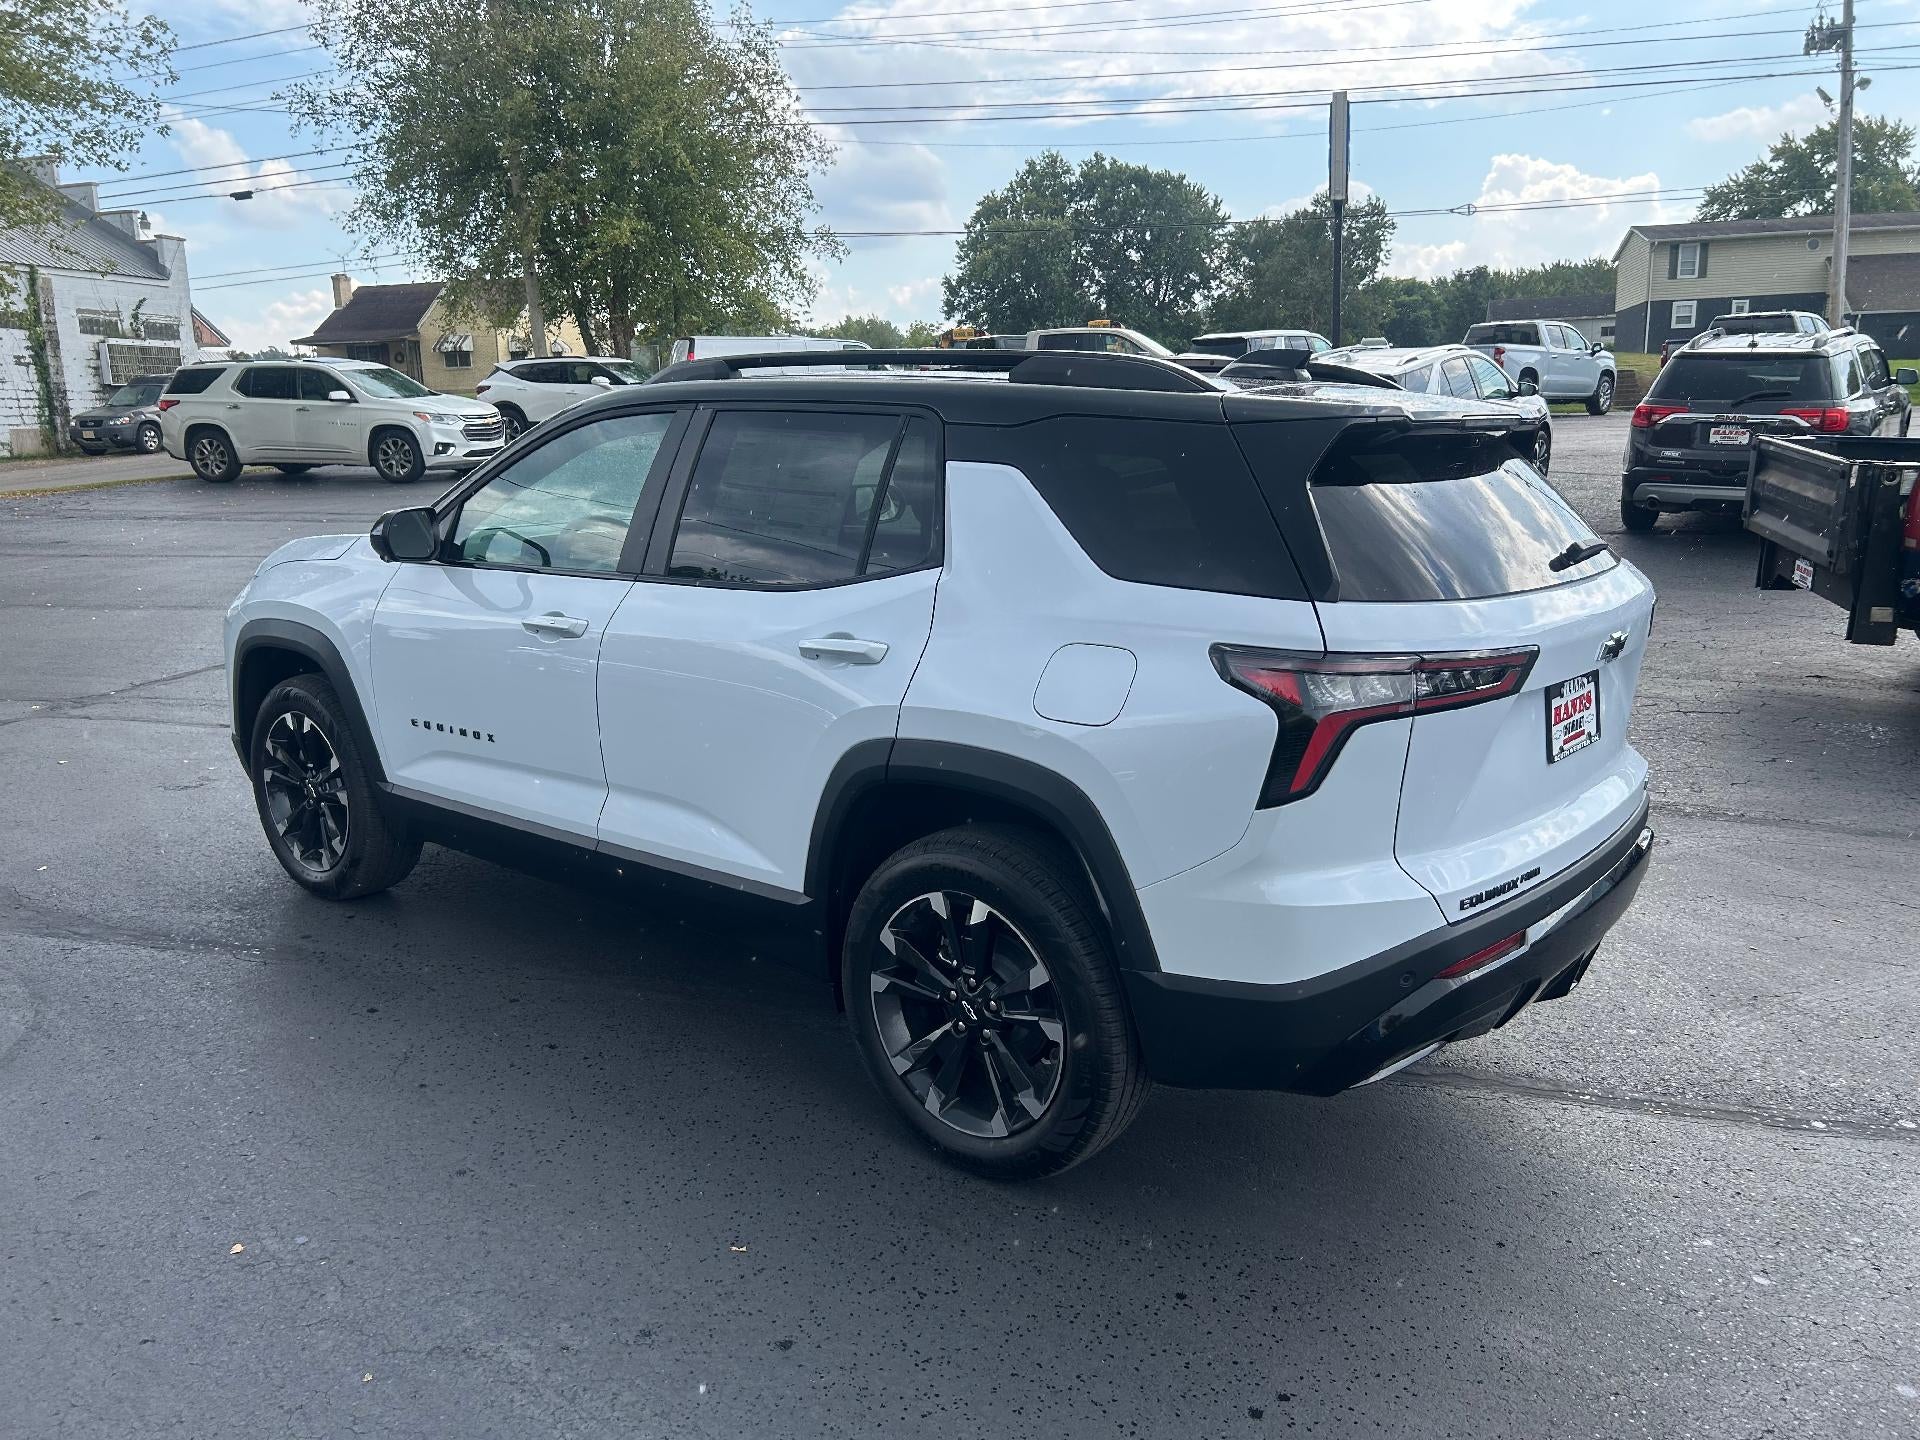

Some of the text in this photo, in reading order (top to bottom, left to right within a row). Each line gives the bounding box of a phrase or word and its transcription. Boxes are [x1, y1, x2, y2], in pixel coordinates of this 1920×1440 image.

[1552, 689, 1592, 727] HANES
[410, 718, 496, 743] EQUINOX
[1459, 876, 1520, 911] EQUINOX
